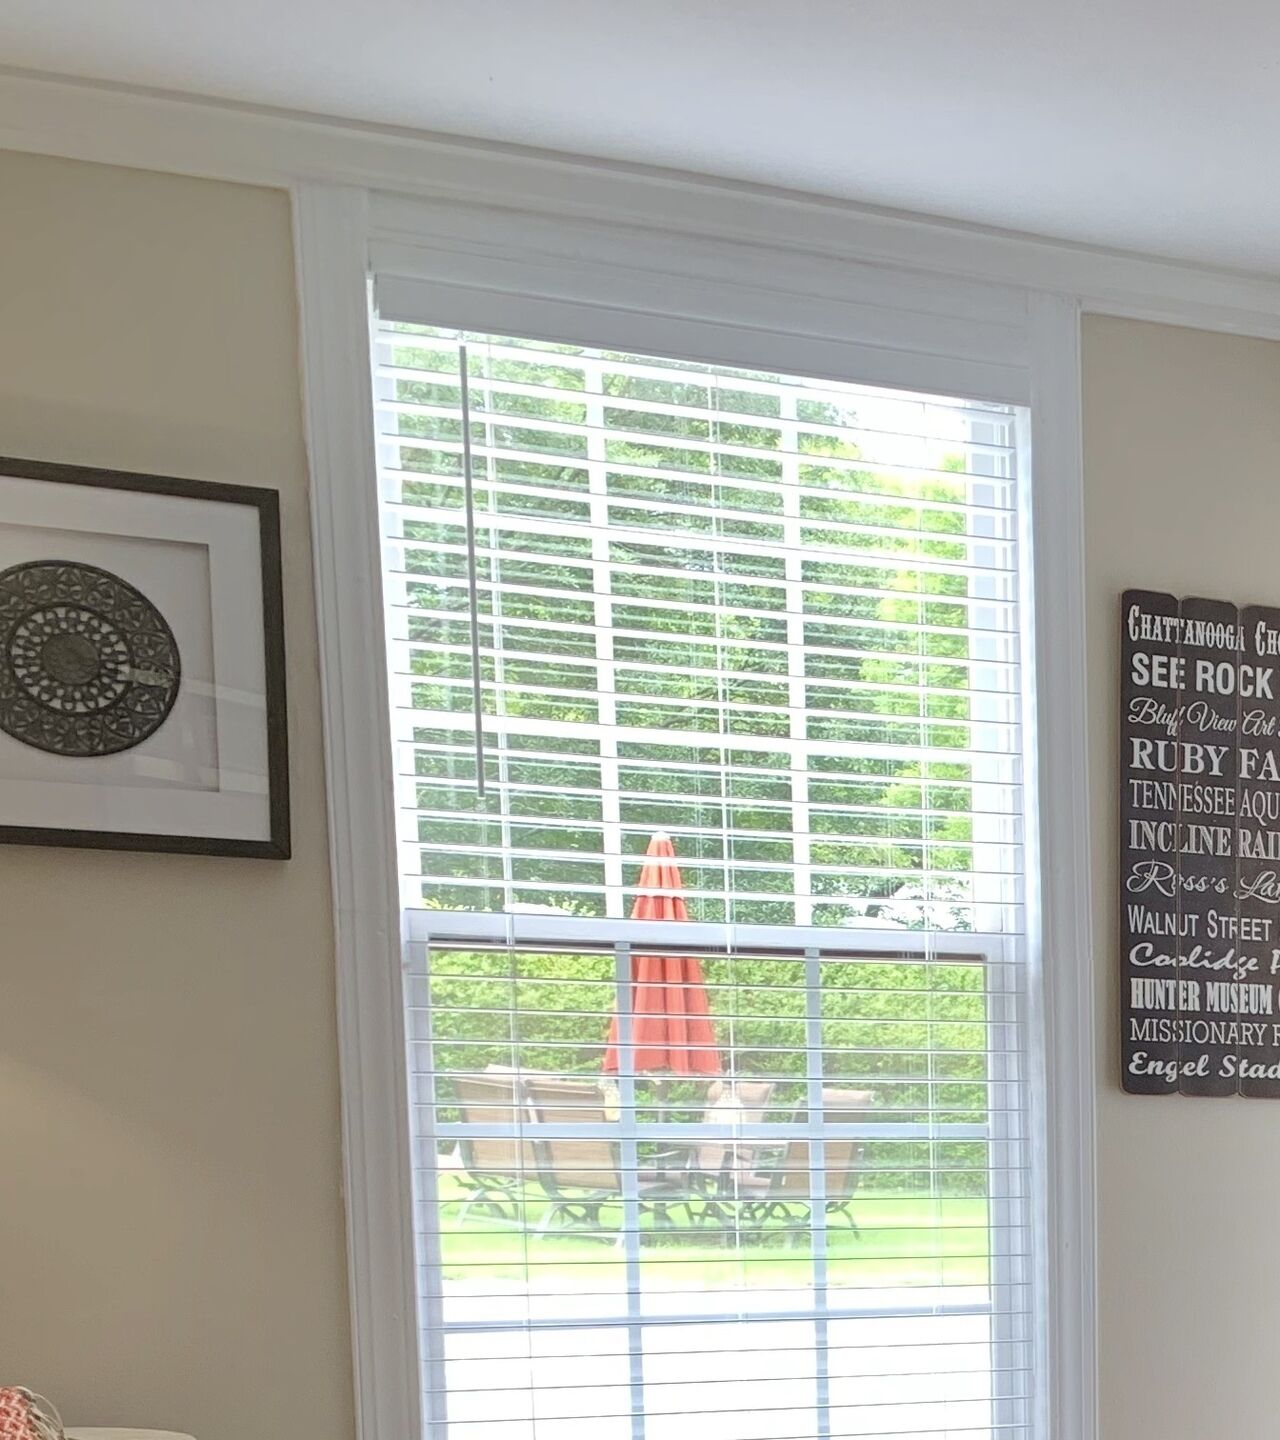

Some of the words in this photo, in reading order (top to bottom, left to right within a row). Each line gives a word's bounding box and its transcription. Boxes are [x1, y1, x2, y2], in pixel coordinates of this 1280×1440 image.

[1131, 652, 1186, 689] SEE
[1196, 660, 1274, 700] ROCK
[1128, 697, 1186, 736] Bluff
[1187, 702, 1238, 733] View
[1242, 710, 1275, 736] Art
[1129, 737, 1229, 776] RUBY
[1129, 779, 1235, 816] TENNESSEE
[1128, 819, 1231, 857] INCLINE
[1126, 859, 1229, 897] Ross's
[1129, 942, 1259, 980] Coolidge
[1130, 977, 1200, 1012] HUNTER
[1206, 981, 1273, 1015] MUSEUM
[1130, 1017, 1271, 1046] MISSIONARY
[1128, 1052, 1210, 1083] Engel
